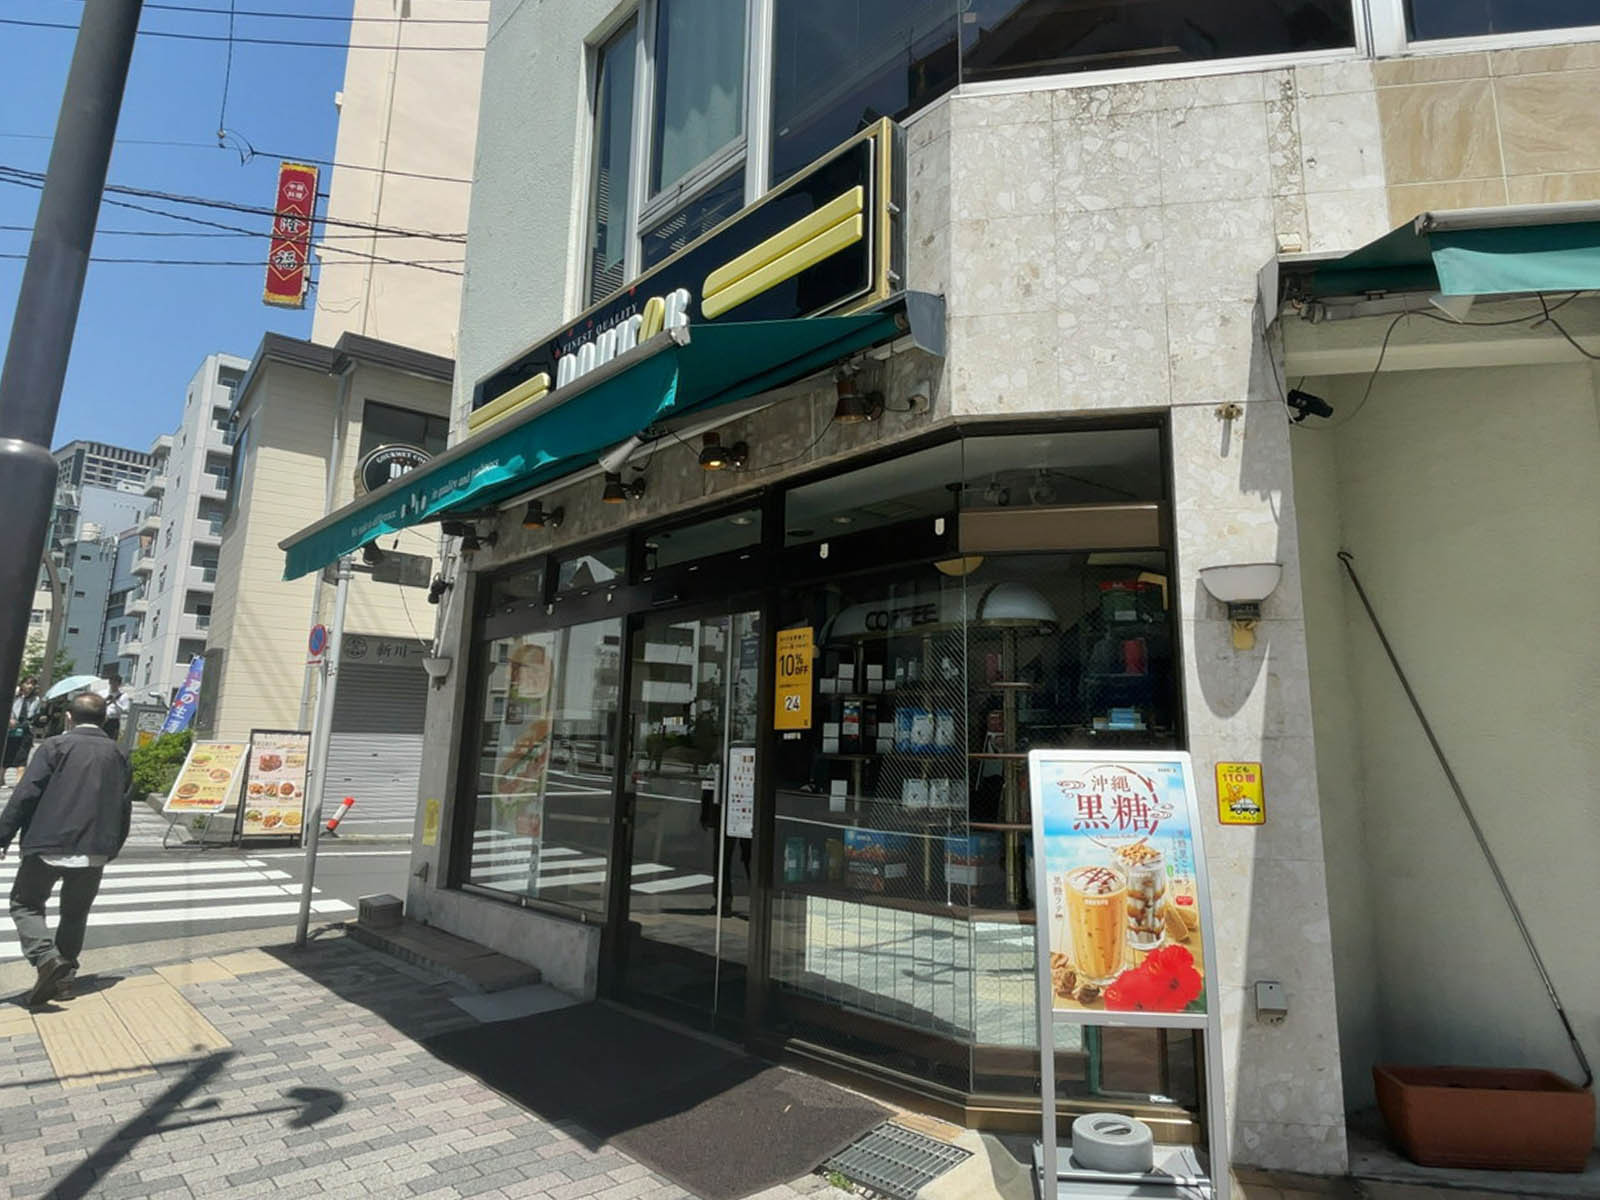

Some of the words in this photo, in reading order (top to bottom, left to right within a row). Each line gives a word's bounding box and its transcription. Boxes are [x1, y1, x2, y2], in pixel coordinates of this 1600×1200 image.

[563, 329, 593, 354] FINEST
[595, 302, 638, 335] QUALITY
[865, 603, 939, 631] COFFEE
[795, 665, 808, 675] OFF
[785, 696, 800, 711] 24
[1073, 793, 1151, 832] 黒糖
